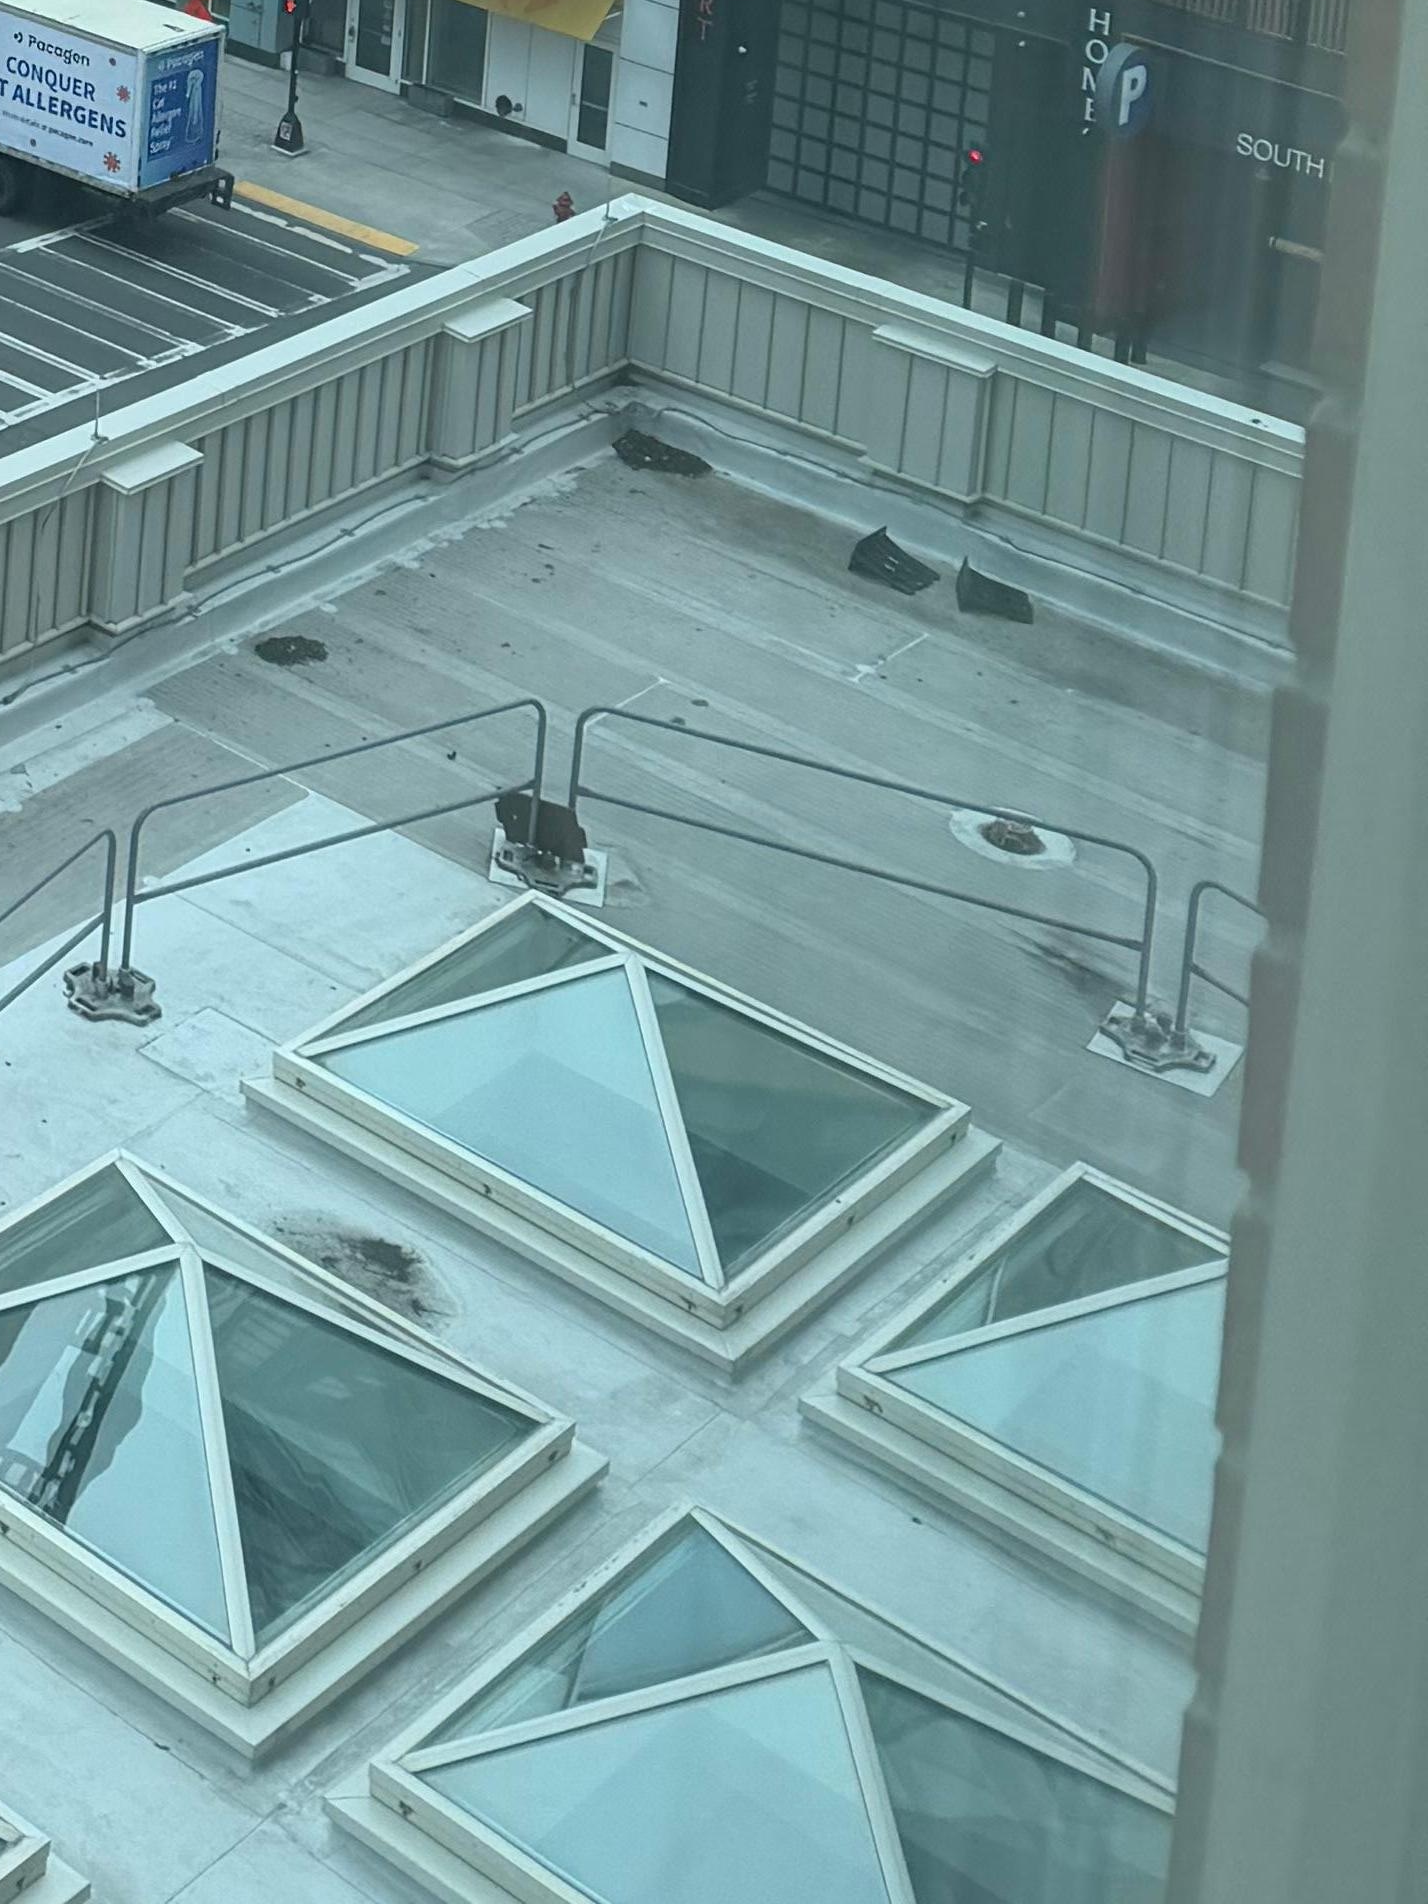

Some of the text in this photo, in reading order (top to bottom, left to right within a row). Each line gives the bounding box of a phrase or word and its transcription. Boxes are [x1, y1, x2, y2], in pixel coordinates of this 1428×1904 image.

[28, 34, 90, 67] Pacagen
[1082, 8, 1111, 135] HOME
[6, 56, 96, 101] CONQUER
[1118, 64, 1147, 126] P
[12, 84, 127, 138] ALLERGENS
[1236, 132, 1325, 179] SOUTH
